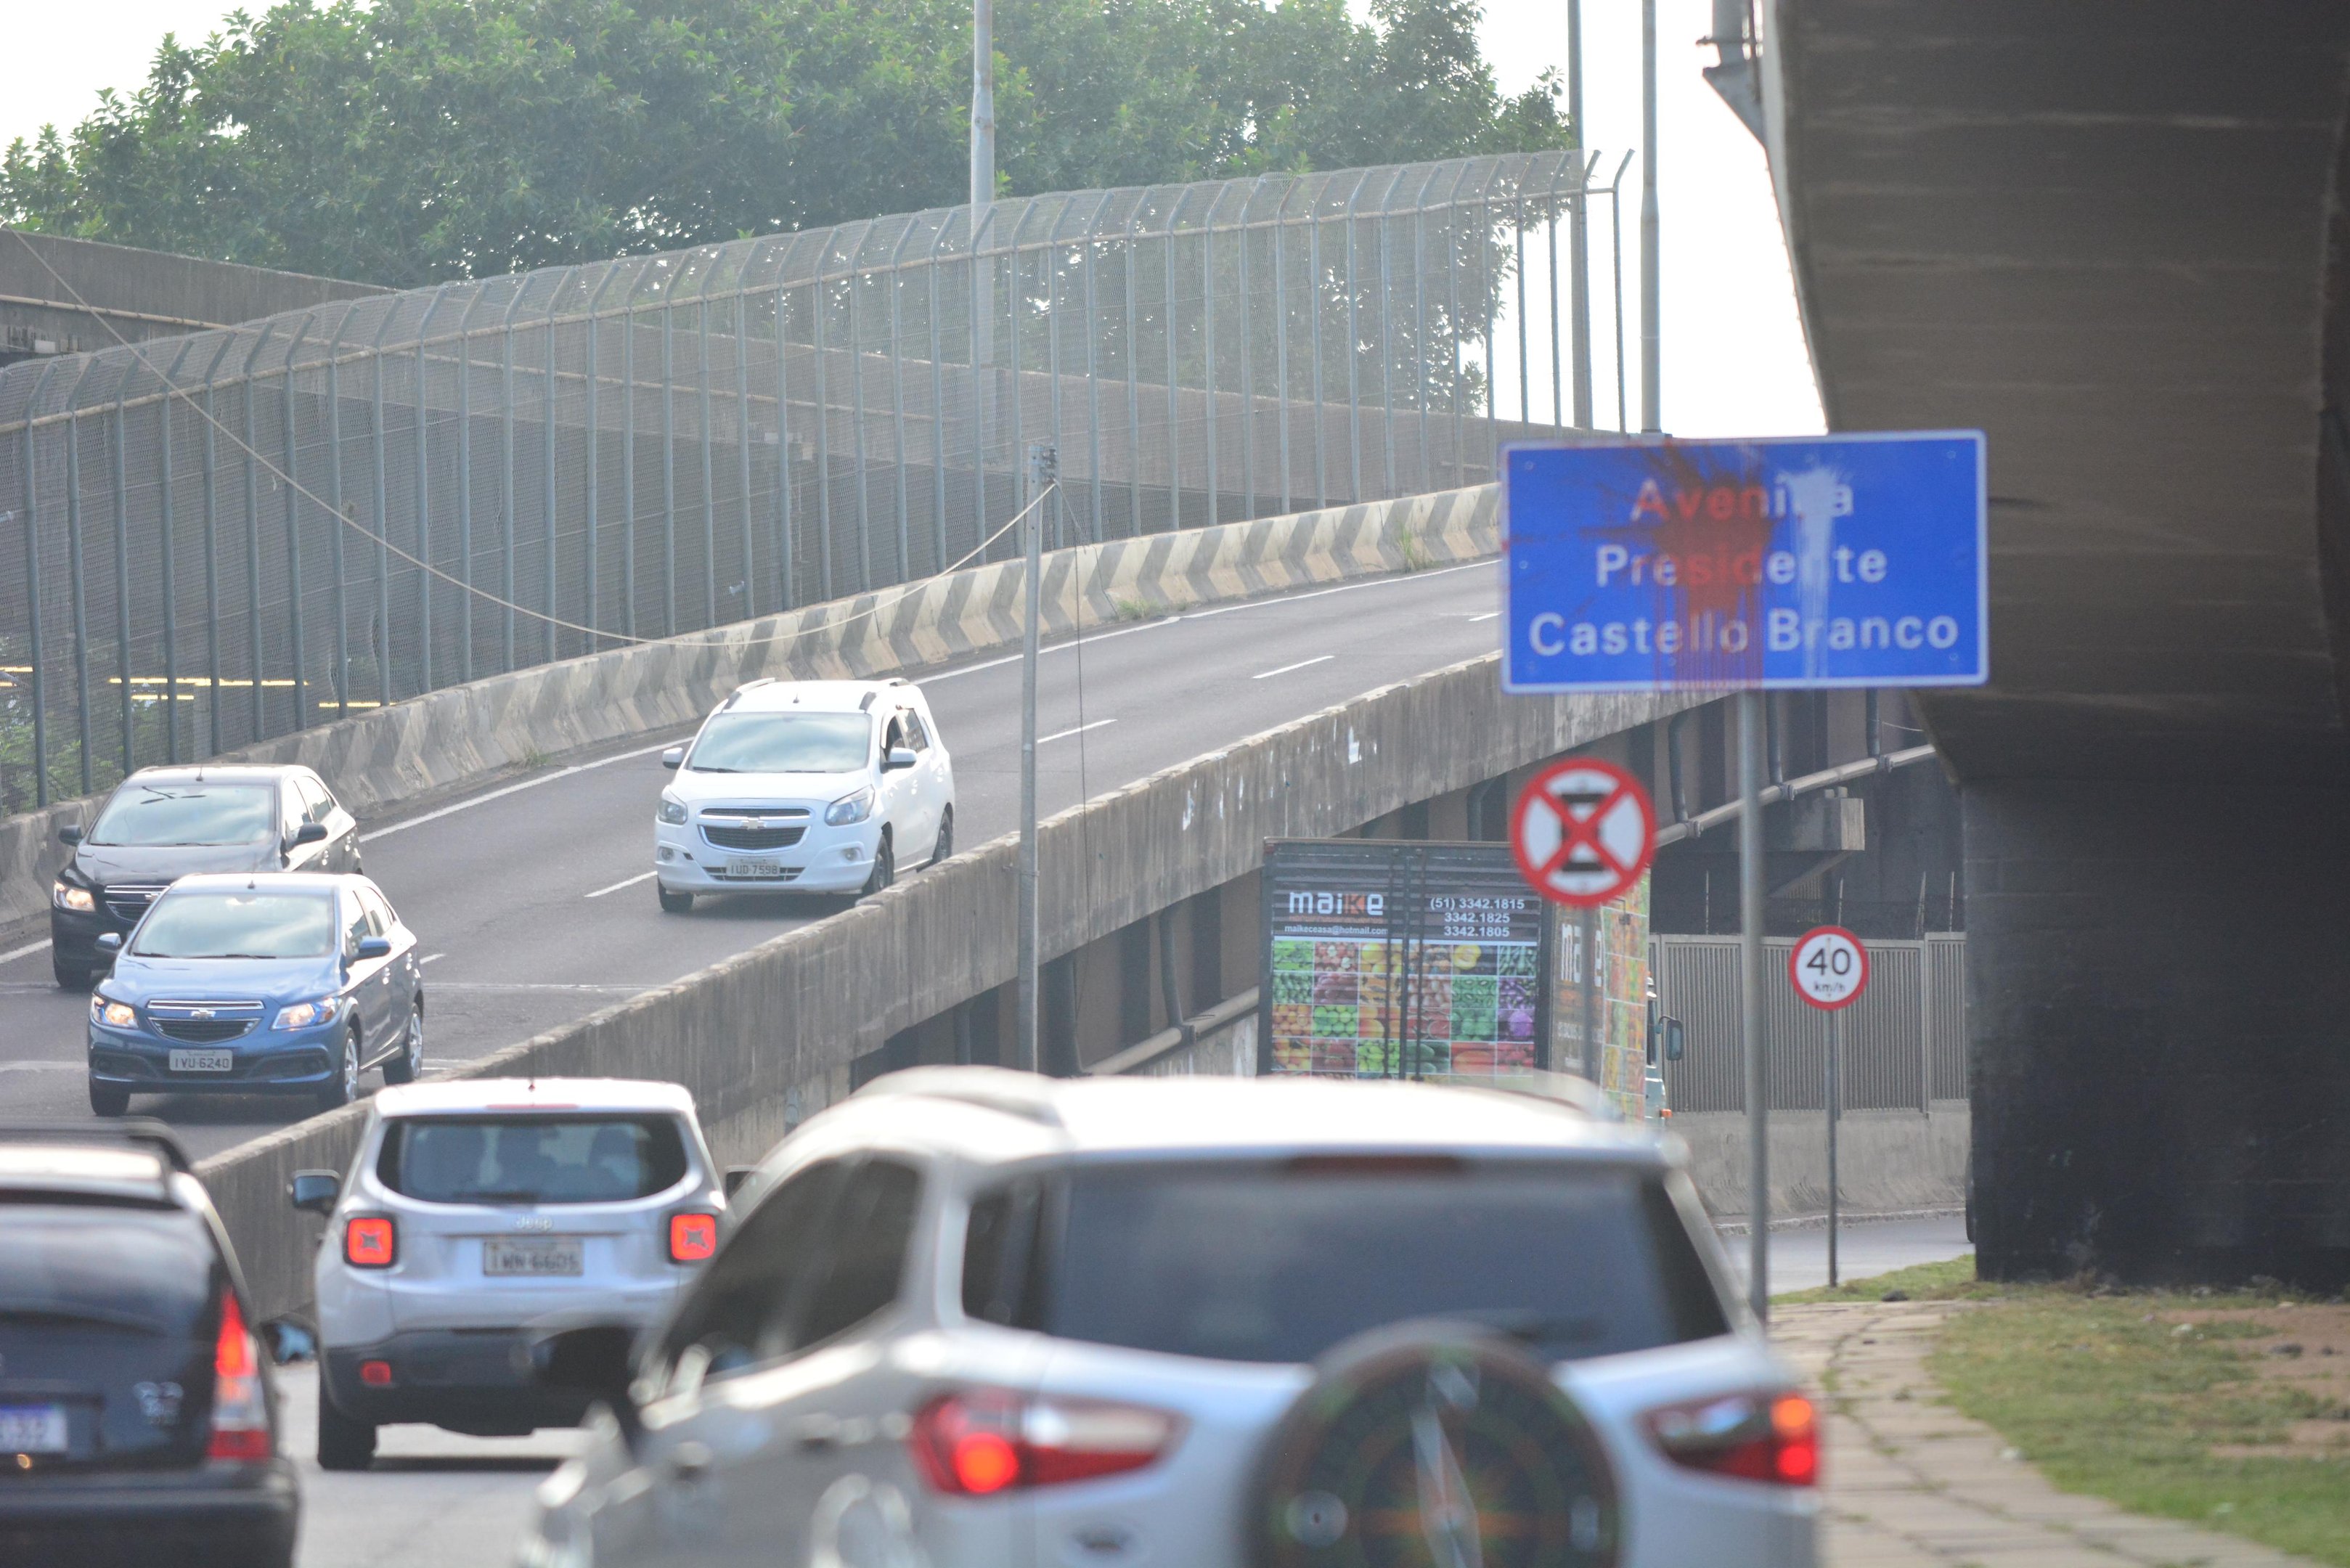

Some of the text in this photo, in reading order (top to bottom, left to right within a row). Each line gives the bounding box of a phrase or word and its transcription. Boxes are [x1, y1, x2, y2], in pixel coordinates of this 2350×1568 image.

[1631, 475, 1854, 521] Avenia
[1596, 543, 1888, 587] Presidete
[1528, 608, 1959, 656] Castello Branco
[1430, 897, 1525, 910] (51) 3342.1815
[1444, 912, 1511, 923] 3342.1825
[1444, 926, 1510, 937] 3342.1805
[1806, 947, 1851, 976] 40
[1814, 981, 1845, 992] km/h
